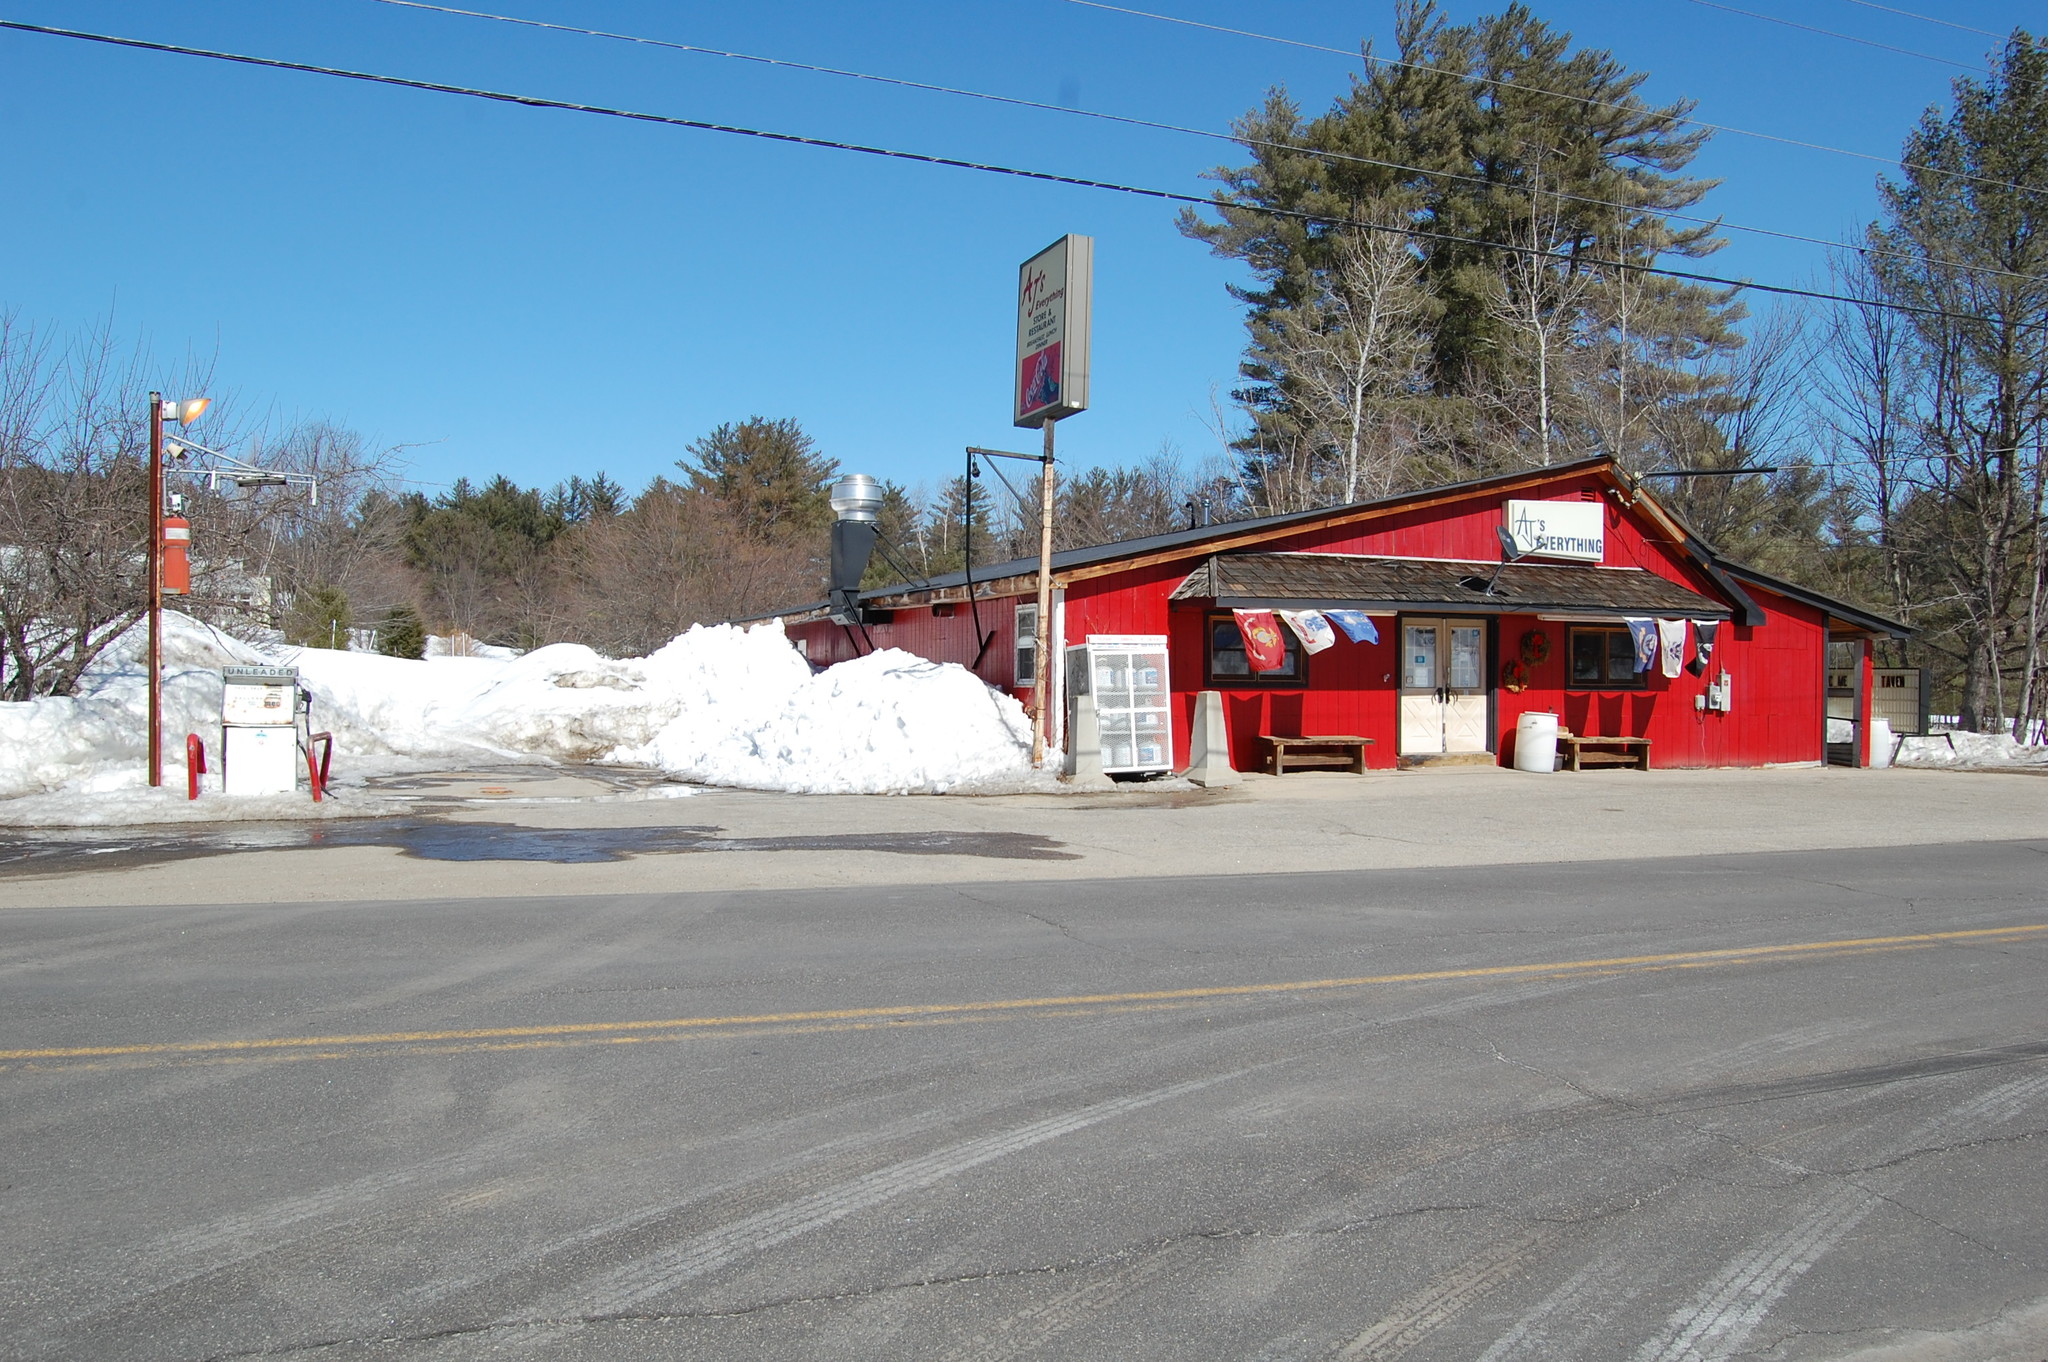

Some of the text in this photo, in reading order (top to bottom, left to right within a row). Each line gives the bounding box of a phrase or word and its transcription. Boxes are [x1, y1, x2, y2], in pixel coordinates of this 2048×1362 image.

[1035, 287, 1064, 311] Everything
[1029, 315, 1057, 336] RESTAURANT
[1033, 308, 1052, 325] STORE &
[228, 668, 293, 676] UNLEADED
